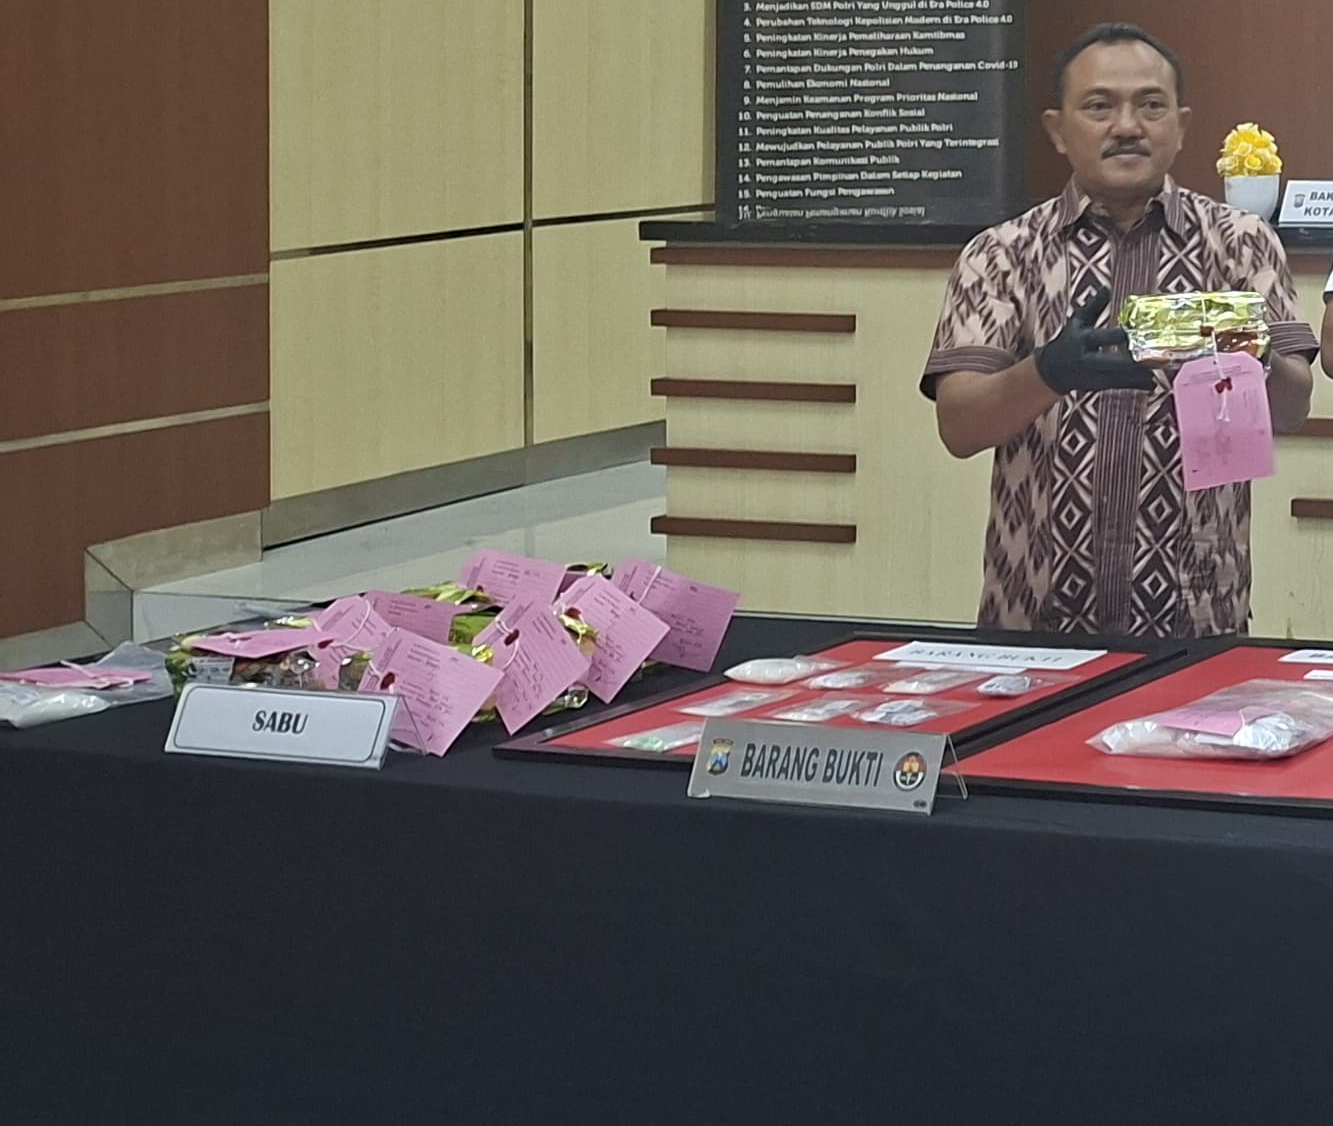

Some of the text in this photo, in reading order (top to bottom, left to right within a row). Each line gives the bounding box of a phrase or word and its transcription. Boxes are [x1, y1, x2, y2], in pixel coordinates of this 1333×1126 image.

[251, 709, 308, 735] SABU
[741, 743, 884, 787] BARANG BUKTI
